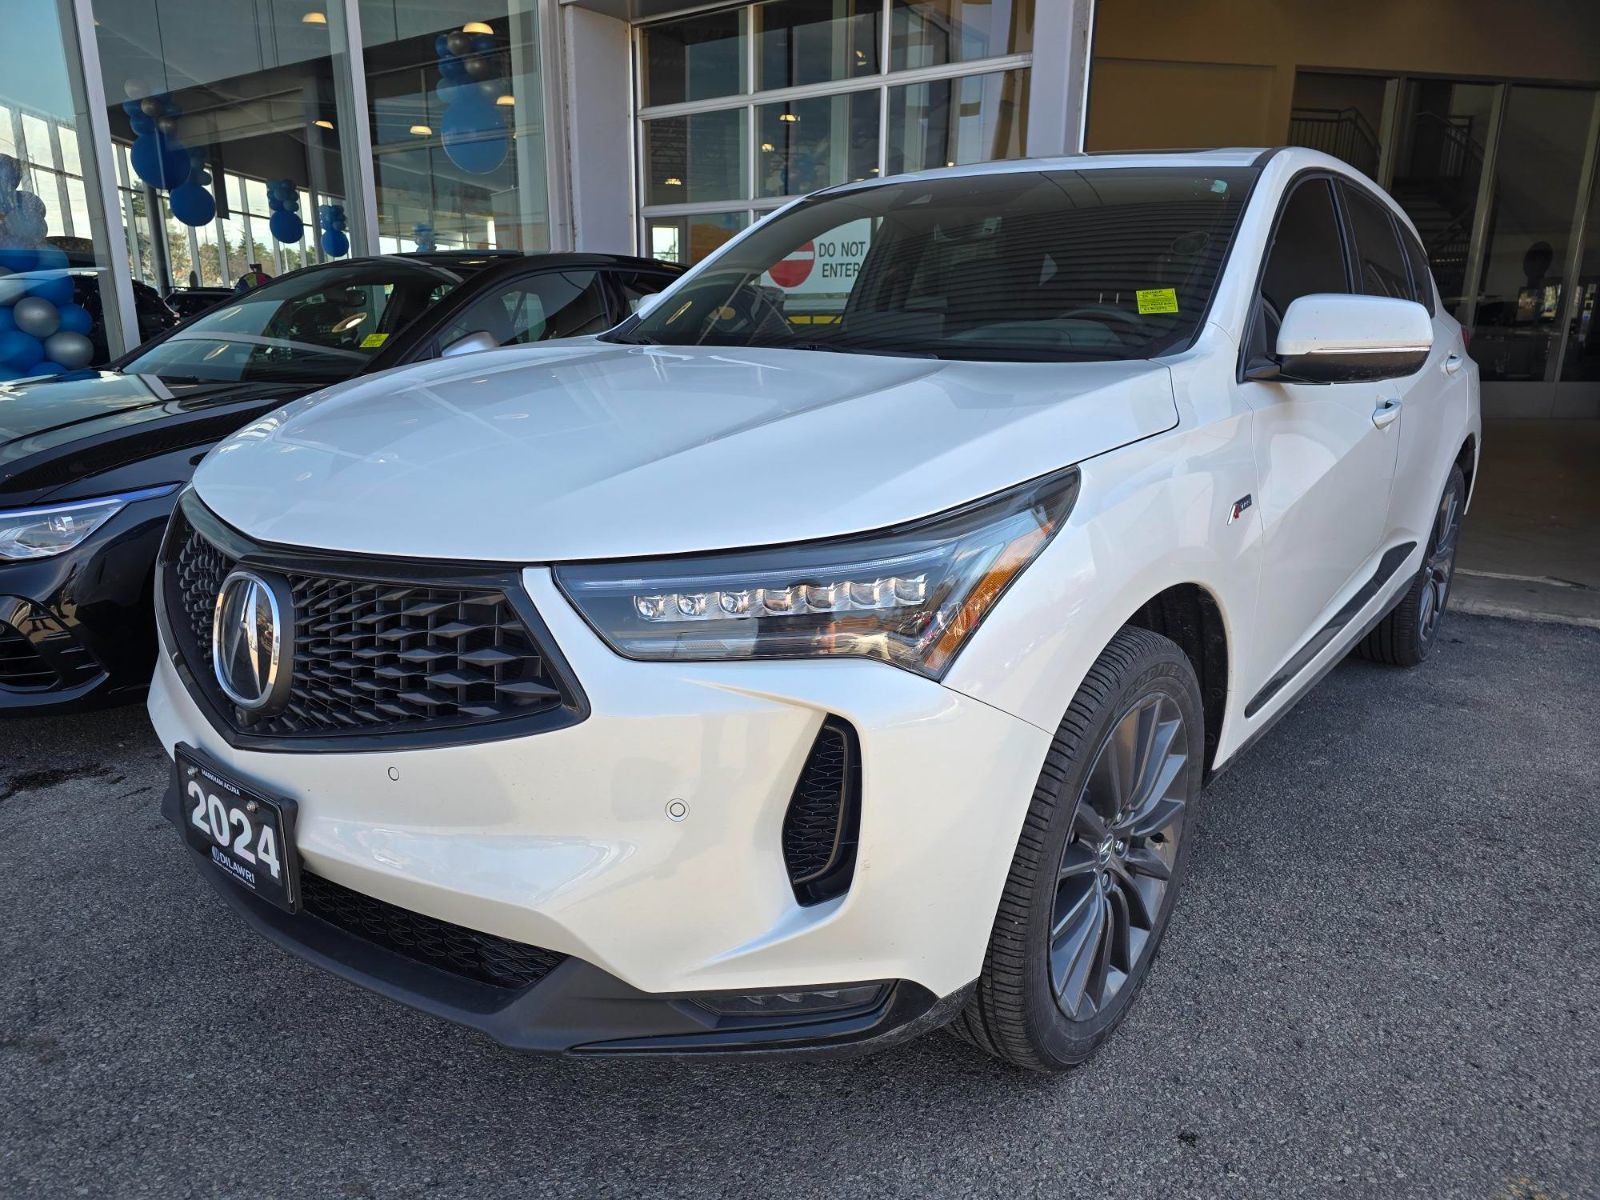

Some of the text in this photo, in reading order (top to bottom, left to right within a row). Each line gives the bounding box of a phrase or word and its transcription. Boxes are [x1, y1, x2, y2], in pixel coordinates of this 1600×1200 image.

[819, 241, 866, 258] DO NOT
[223, 782, 241, 797] ACURA
[188, 780, 280, 879] 2024
[219, 851, 256, 884] DILAWRI
